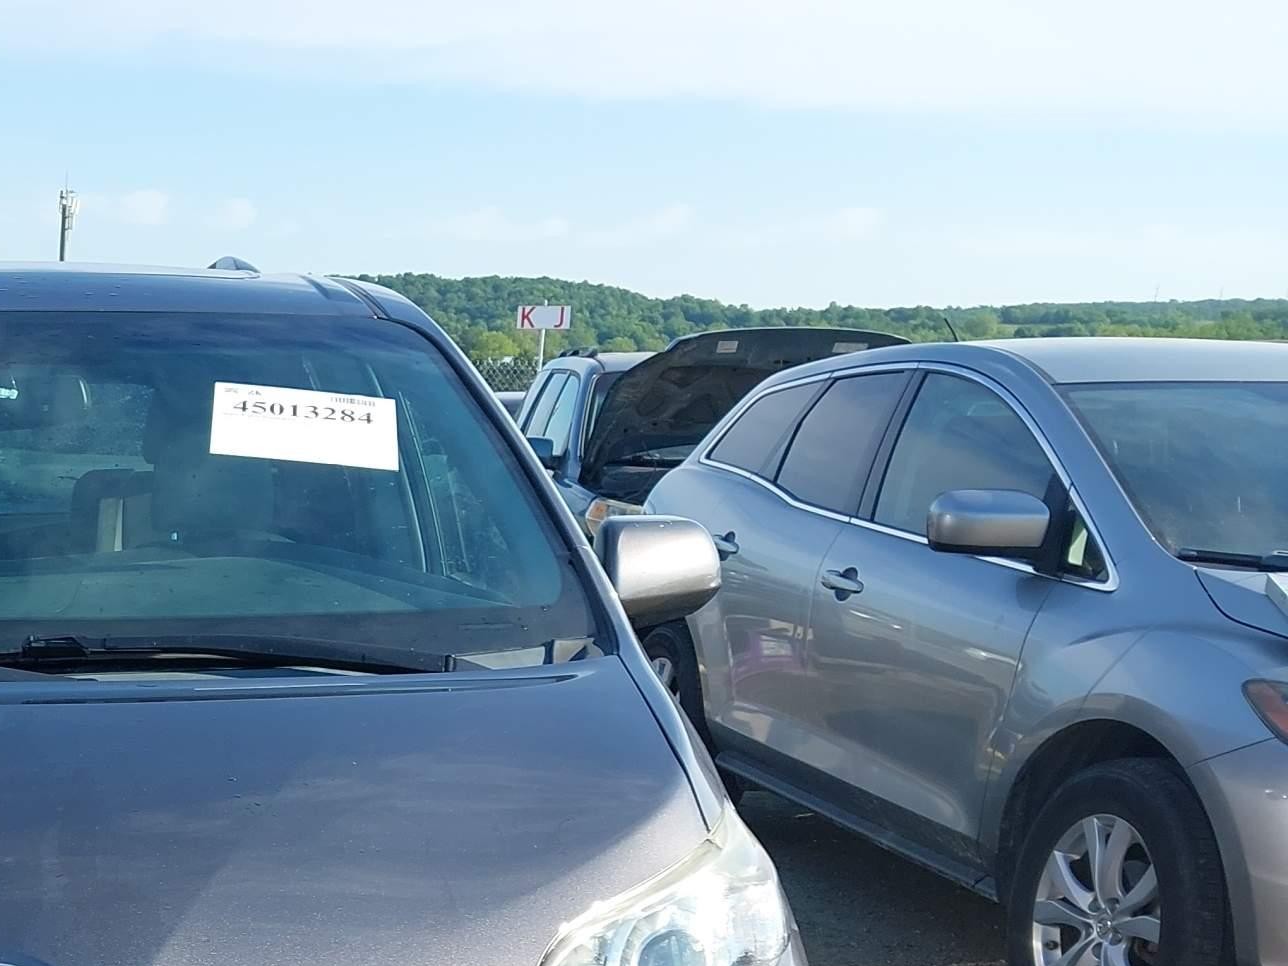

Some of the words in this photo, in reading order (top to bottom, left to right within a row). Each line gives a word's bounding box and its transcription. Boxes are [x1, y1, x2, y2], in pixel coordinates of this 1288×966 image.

[520, 306, 536, 328] K
[553, 306, 565, 328] J
[233, 399, 374, 425] 45013284
